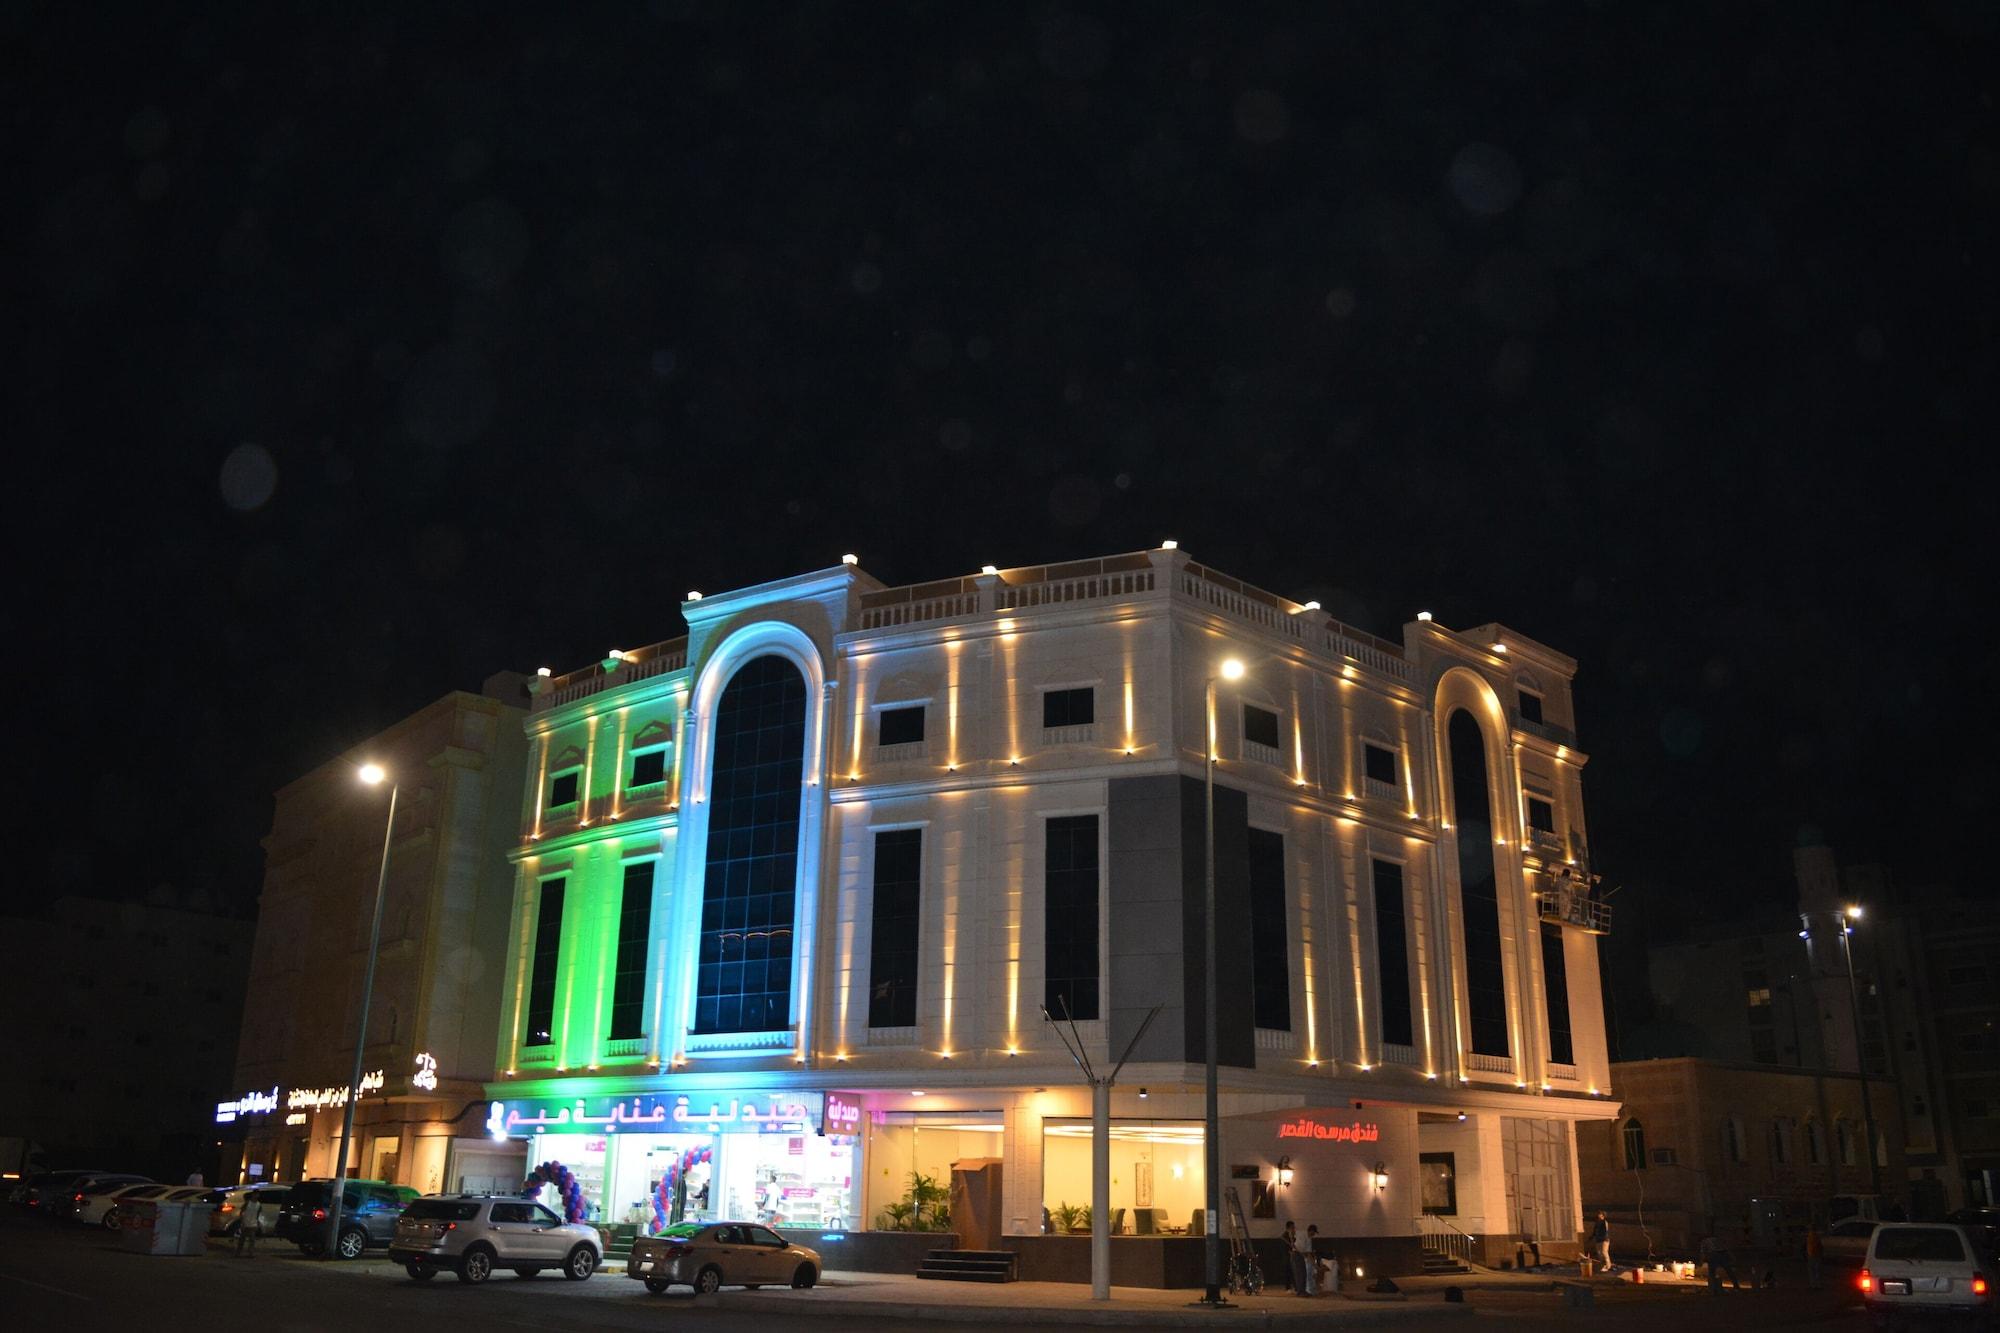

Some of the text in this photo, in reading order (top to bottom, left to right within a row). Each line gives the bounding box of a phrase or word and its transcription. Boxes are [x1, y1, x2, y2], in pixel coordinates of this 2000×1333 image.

[506, 1097, 807, 1133] صيدلية عناية ميم
[828, 1096, 859, 1130] صيدلية
[1279, 1119, 1378, 1143] فندق مرسى القصر
